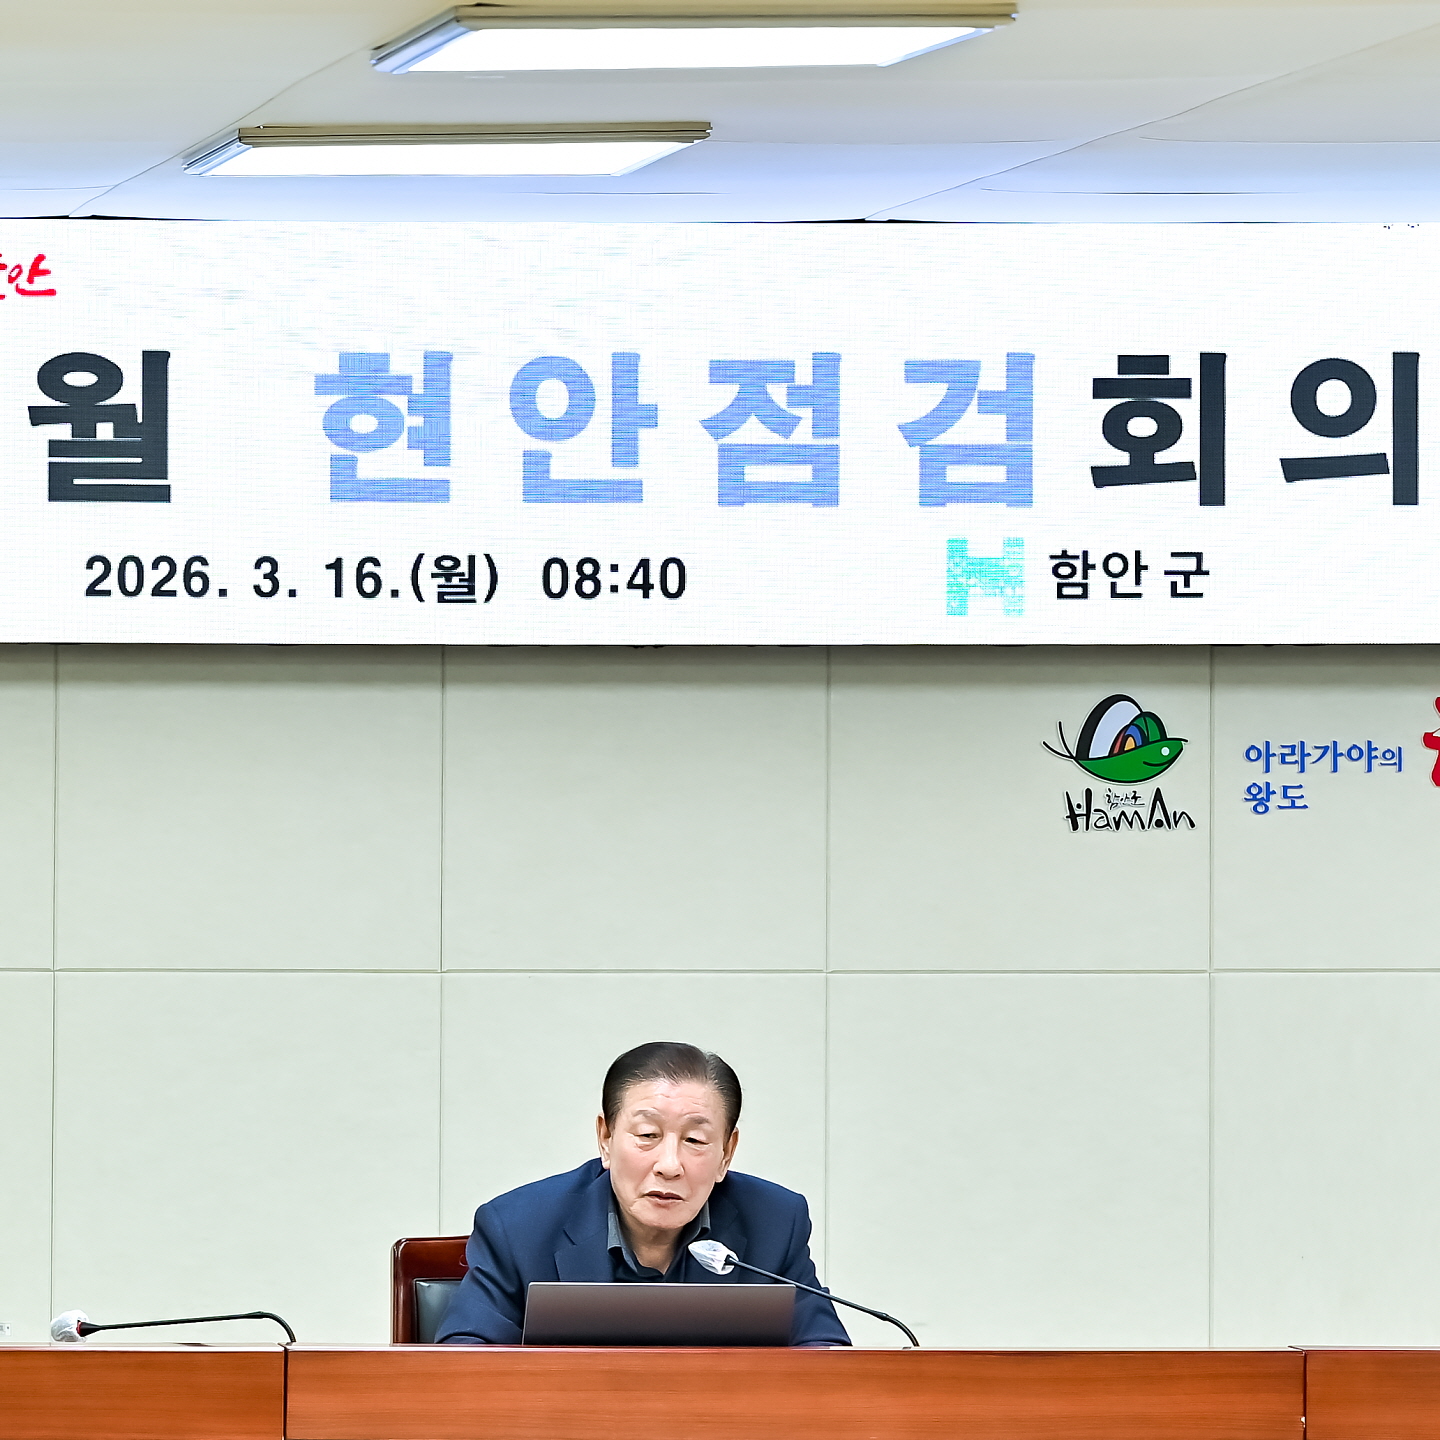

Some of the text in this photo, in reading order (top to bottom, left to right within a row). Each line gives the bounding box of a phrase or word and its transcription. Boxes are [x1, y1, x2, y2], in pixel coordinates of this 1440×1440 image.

[84, 555, 229, 599] 2026.
[251, 555, 299, 599] 3.
[540, 556, 688, 601] 08:40
[1244, 740, 1404, 774] 아라가야의
[1064, 786, 1197, 833] HamAn
[1244, 781, 1310, 816] 왕도
